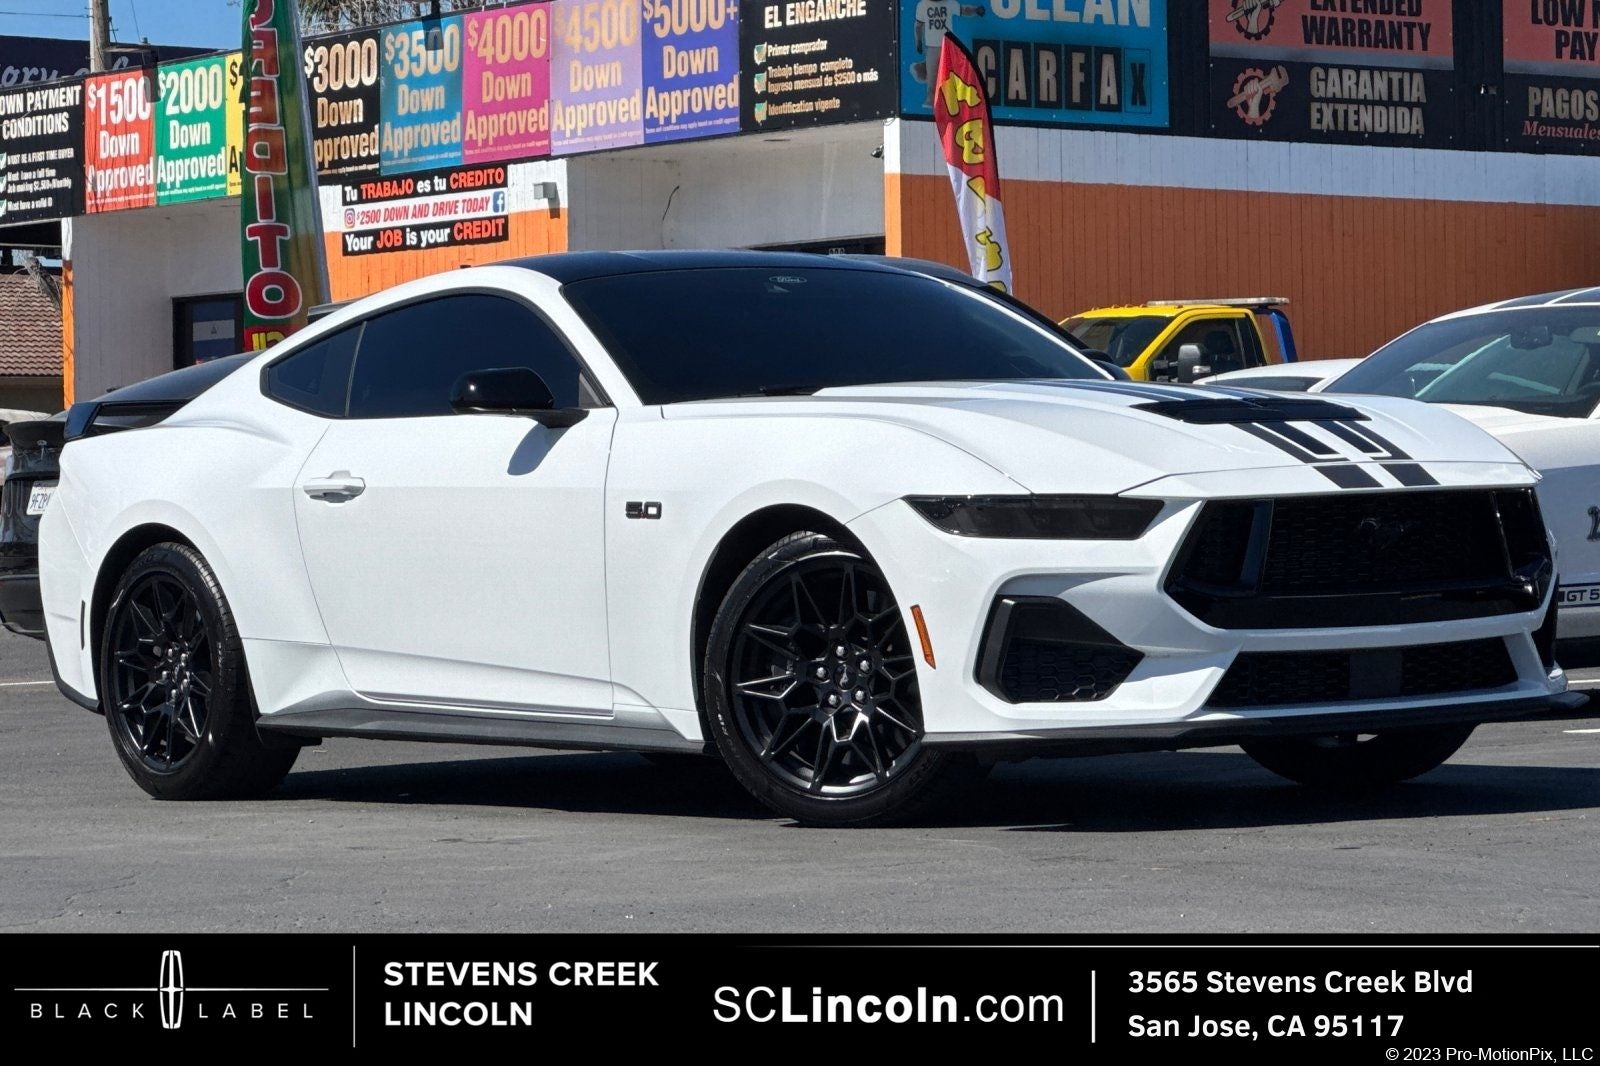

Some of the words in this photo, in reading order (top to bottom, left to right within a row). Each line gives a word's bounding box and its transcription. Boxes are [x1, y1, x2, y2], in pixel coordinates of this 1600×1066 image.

[552, 1, 638, 54] $4500
[643, 0, 738, 38] $5000+
[764, 5, 782, 29] EL
[786, 0, 867, 26] ENGANCHE
[927, 6, 947, 18] CAR
[929, 19, 947, 30] FOX
[1531, 0, 1585, 28] LOW
[468, 8, 548, 65] $4000
[768, 44, 790, 58] Primer
[791, 38, 828, 55] comprador
[1302, 15, 1432, 51] WARRANTY
[1555, 30, 1598, 62] PAY
[304, 38, 378, 92] $3000
[384, 23, 460, 80] $3500
[662, 45, 718, 79] Down
[569, 59, 622, 93] Down
[768, 64, 793, 80] Trabajo
[794, 62, 817, 76] tiempo
[820, 58, 854, 74] completo
[768, 80, 793, 95] Ingreso
[794, 75, 822, 90] mensual
[824, 74, 833, 86] de
[834, 70, 856, 88] $2500
[856, 72, 862, 82] o
[862, 68, 878, 82] más
[977, 46, 1146, 106] CARFAX
[1310, 66, 1426, 103] GARANTIA
[0, 93, 24, 116] OWN
[26, 85, 82, 112] PAYMENT
[88, 76, 151, 126] $1500
[158, 64, 222, 116] $2000
[398, 84, 445, 116] Down
[481, 70, 532, 104] Down
[645, 74, 739, 124] Approved
[1528, 86, 1599, 121] PAGOS
[316, 96, 364, 128] Down
[552, 88, 641, 138] Approved
[815, 97, 840, 112] vigente
[1310, 102, 1425, 136] EXTENDIDA
[2, 112, 70, 140] CONDITIONS
[170, 120, 210, 150] Down
[382, 112, 462, 158] Approved
[464, 99, 549, 147] Approved
[100, 130, 140, 159] Down
[314, 124, 380, 168] pproved
[87, 157, 154, 196] Approved
[156, 147, 226, 188] Approved
[344, 186, 358, 201] Tu
[360, 178, 414, 200] TRABAJO
[416, 180, 431, 193] es
[434, 175, 446, 191] tu
[450, 168, 505, 189] CREDITO
[356, 210, 381, 226] $2500
[383, 206, 409, 222] DOWN
[411, 204, 429, 219] AND
[432, 200, 459, 217] DRIVE
[462, 196, 490, 213] TODAY
[345, 234, 374, 251] Your
[376, 230, 402, 248] JOB
[406, 228, 417, 245] is
[420, 227, 450, 248] your
[454, 218, 505, 241] CREDIT
[625, 501, 662, 520] 5.0
[1566, 590, 1587, 602] GT
